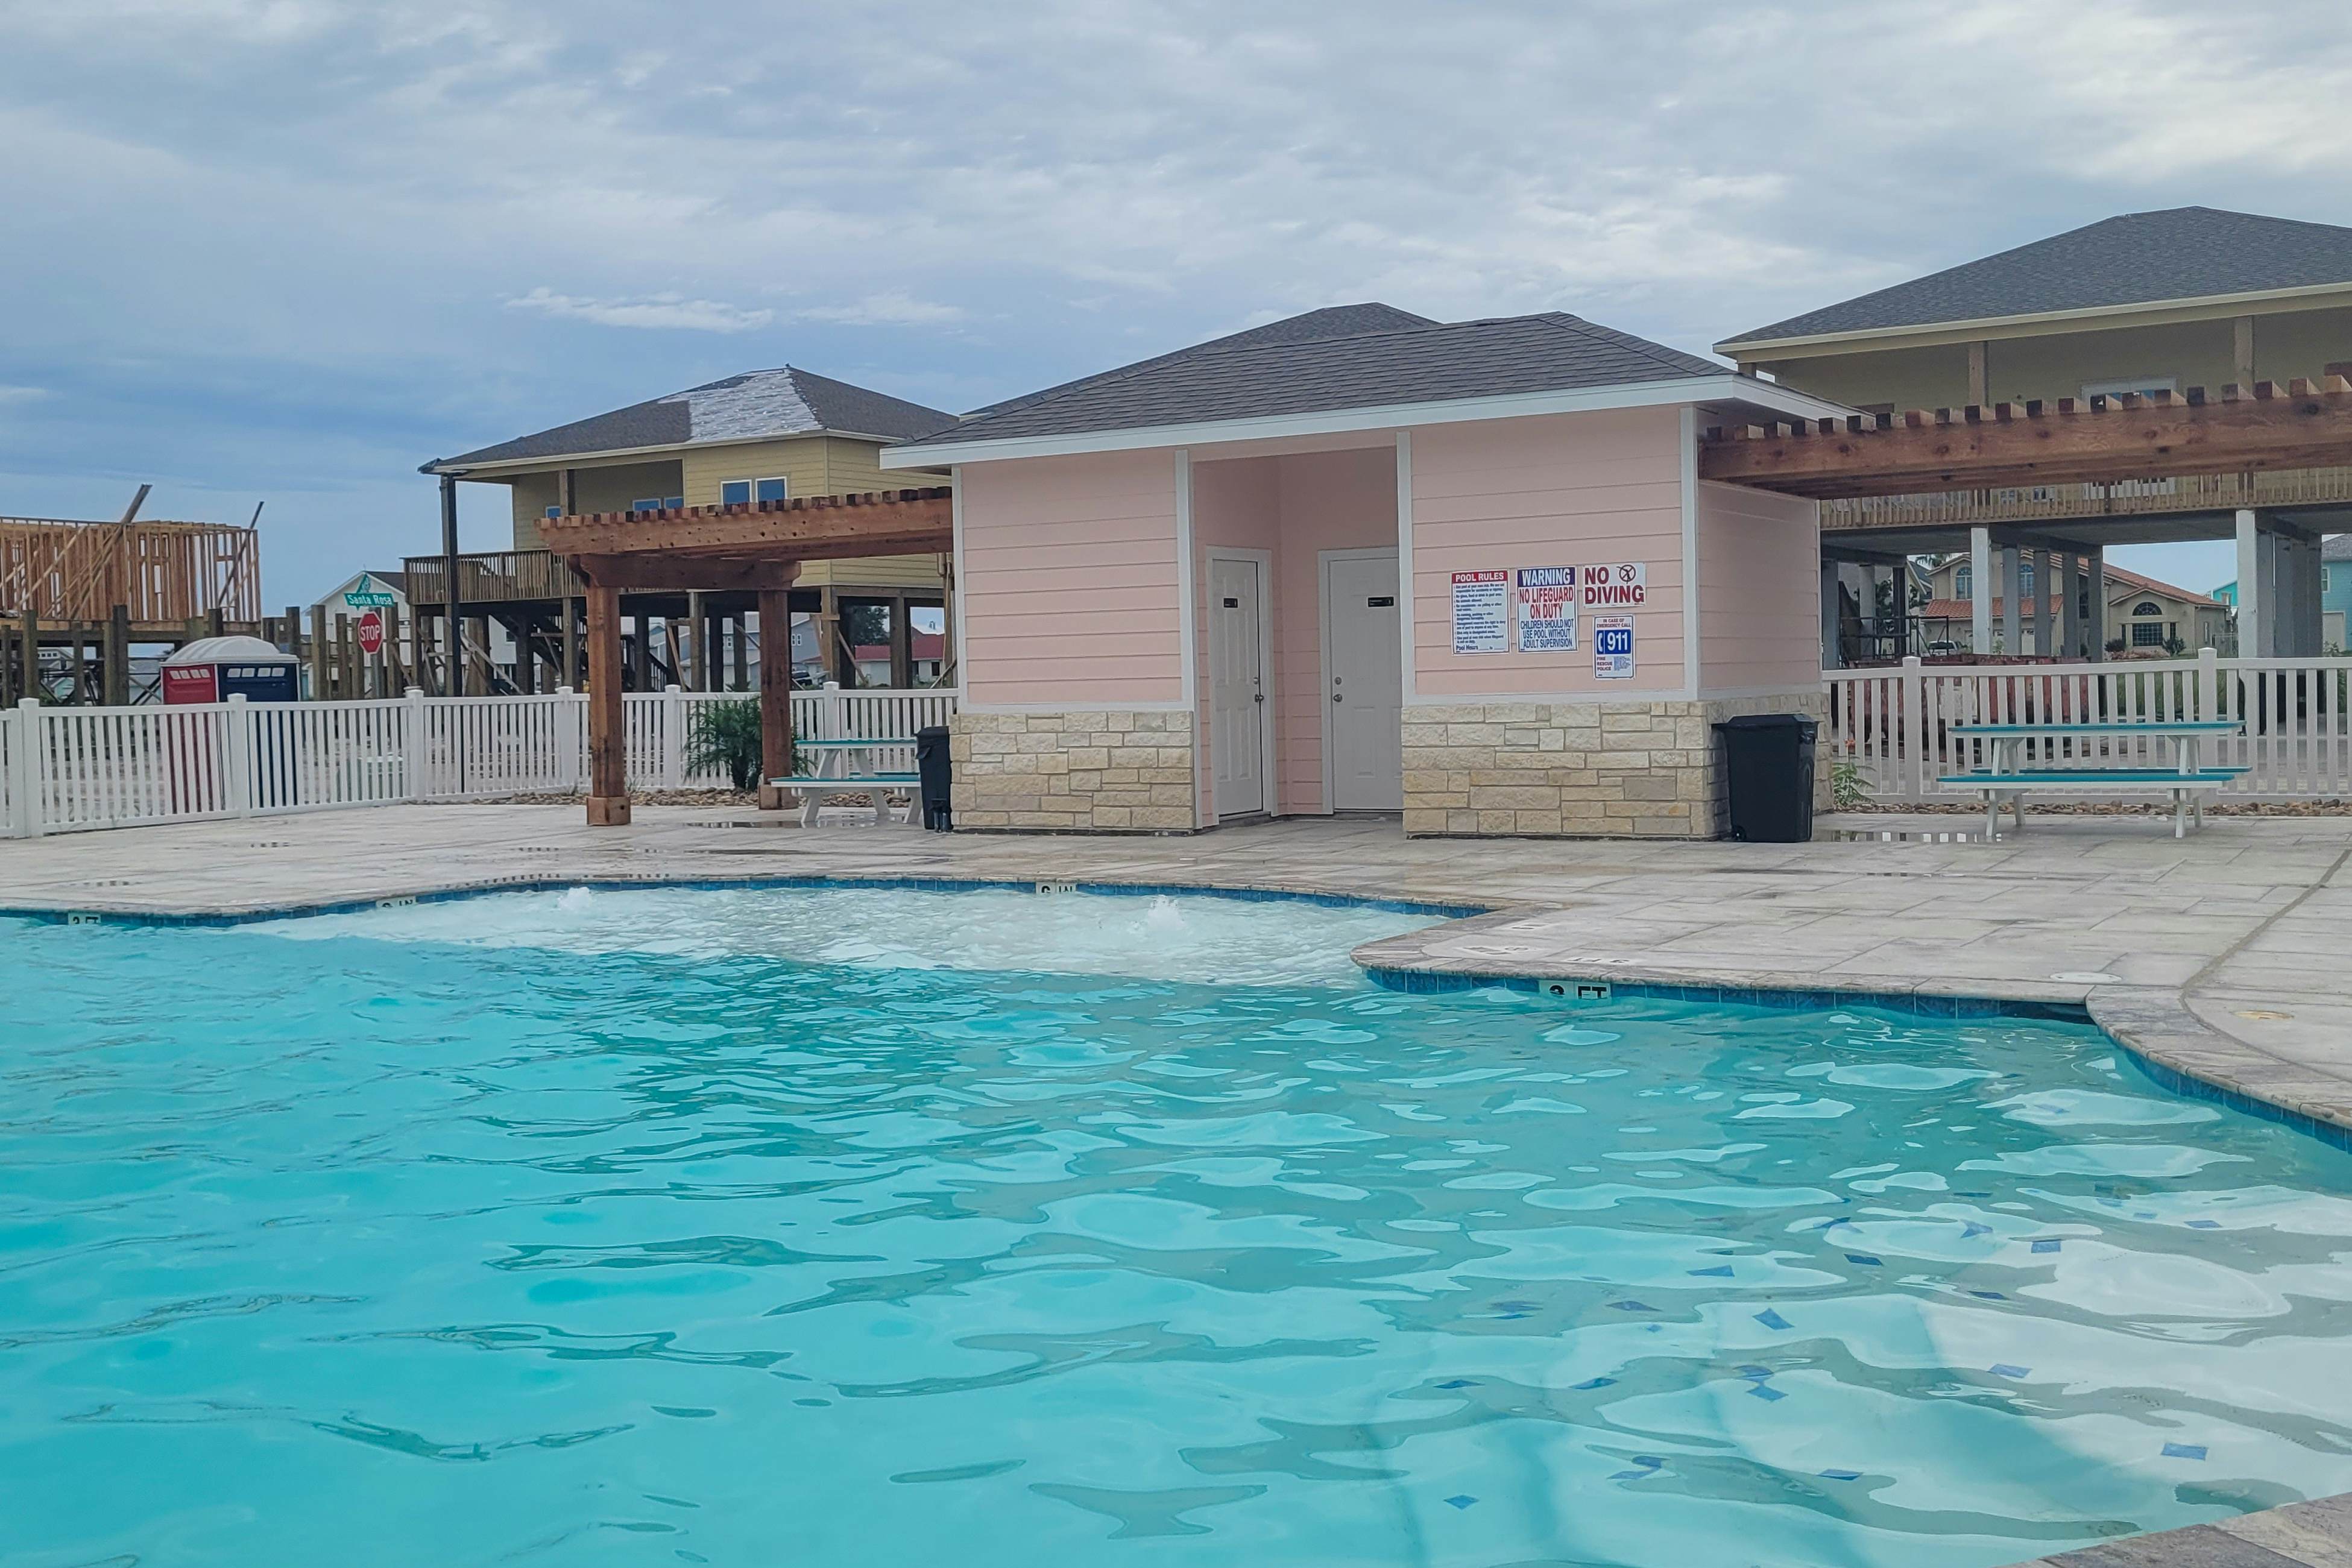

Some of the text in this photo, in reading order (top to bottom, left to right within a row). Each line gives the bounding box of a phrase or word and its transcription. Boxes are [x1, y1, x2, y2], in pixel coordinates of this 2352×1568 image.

[1455, 572, 1504, 582] POOL RULES
[1522, 568, 1571, 586] WARNING
[1584, 567, 1609, 585] NO
[347, 594, 393, 605] Santa Rosa
[1519, 586, 1574, 604] NO LIFEGUARD
[1584, 584, 1644, 604] DIVING
[1530, 602, 1563, 619] ON DUTY
[1521, 619, 1574, 629] CHILDREN SHOULD NOT
[360, 625, 380, 641] STOP
[1523, 628, 1571, 639] USE POOL WITHOUT
[1607, 631, 1628, 651] 911
[1524, 638, 1572, 649] ADULT SUPERVISION
